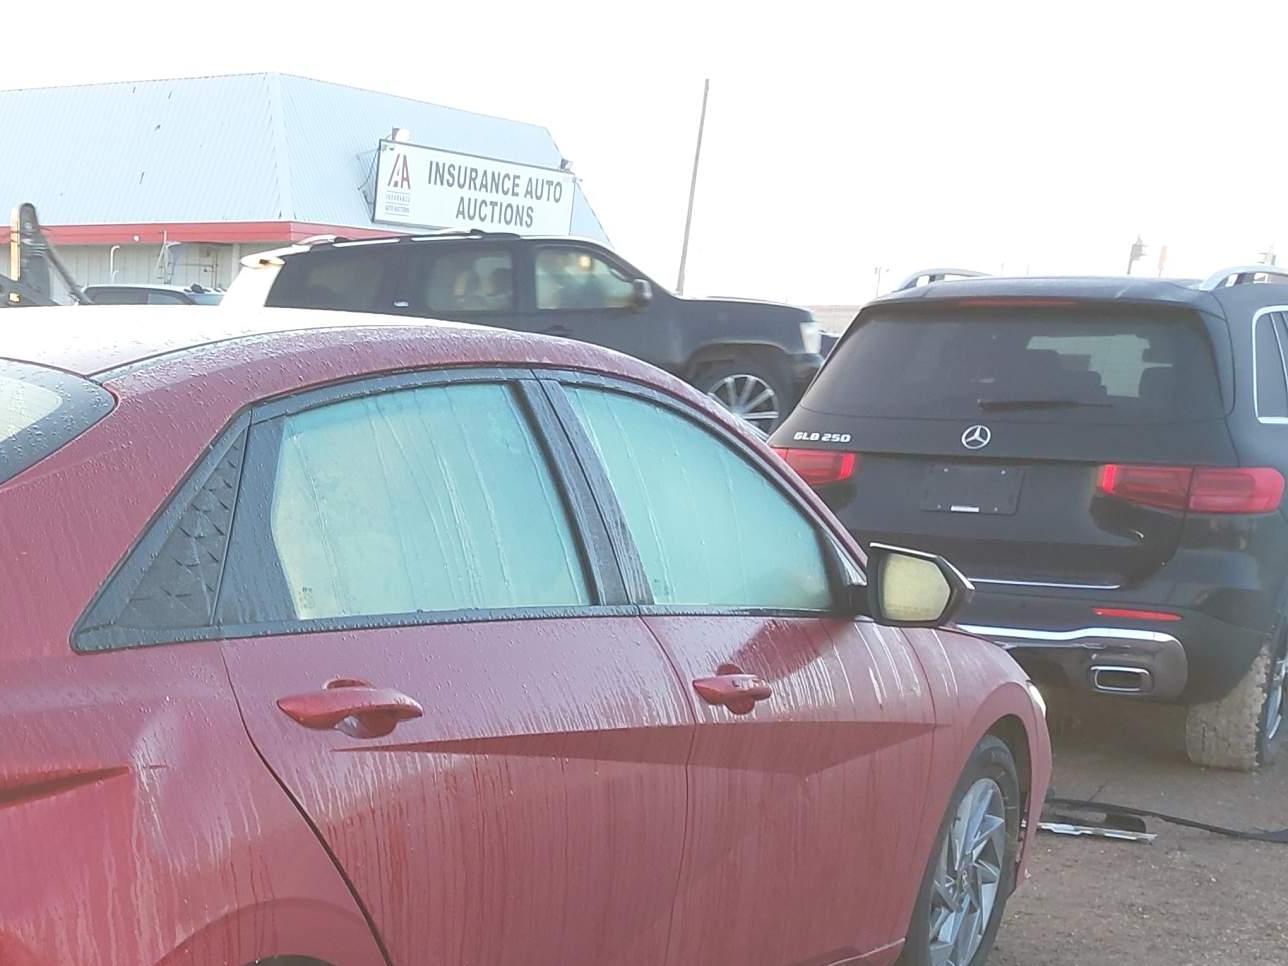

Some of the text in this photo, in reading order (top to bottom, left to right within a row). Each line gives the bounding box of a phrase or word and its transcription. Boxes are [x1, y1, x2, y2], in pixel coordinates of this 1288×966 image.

[427, 160, 563, 203] INSURANCE AUTO
[455, 196, 534, 228] AUCTIONS
[793, 431, 851, 442] GLB 250
